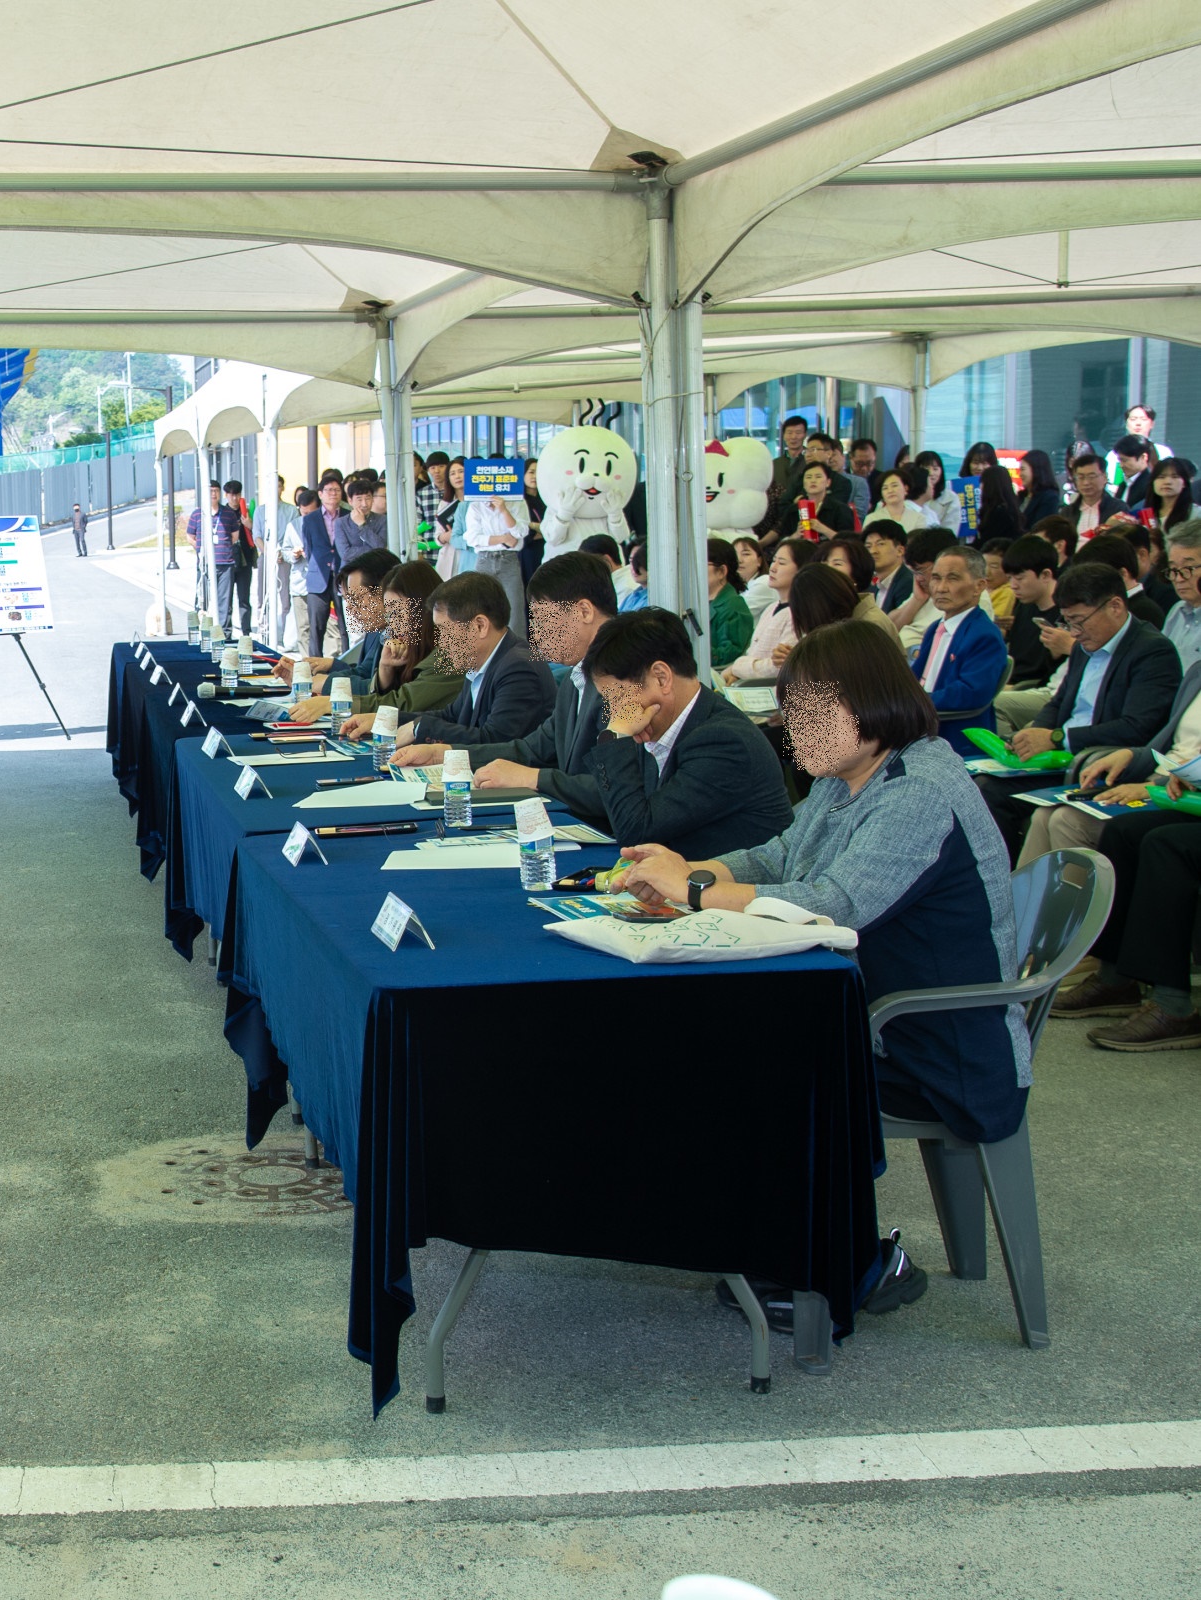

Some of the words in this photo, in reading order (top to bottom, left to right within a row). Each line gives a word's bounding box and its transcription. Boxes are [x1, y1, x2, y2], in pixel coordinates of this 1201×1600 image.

[476, 466, 514, 474] 천연물소재
[471, 475, 494, 483] 전주기
[495, 475, 518, 483] 표준화
[478, 484, 494, 492] 허브
[495, 484, 510, 492] 유치
